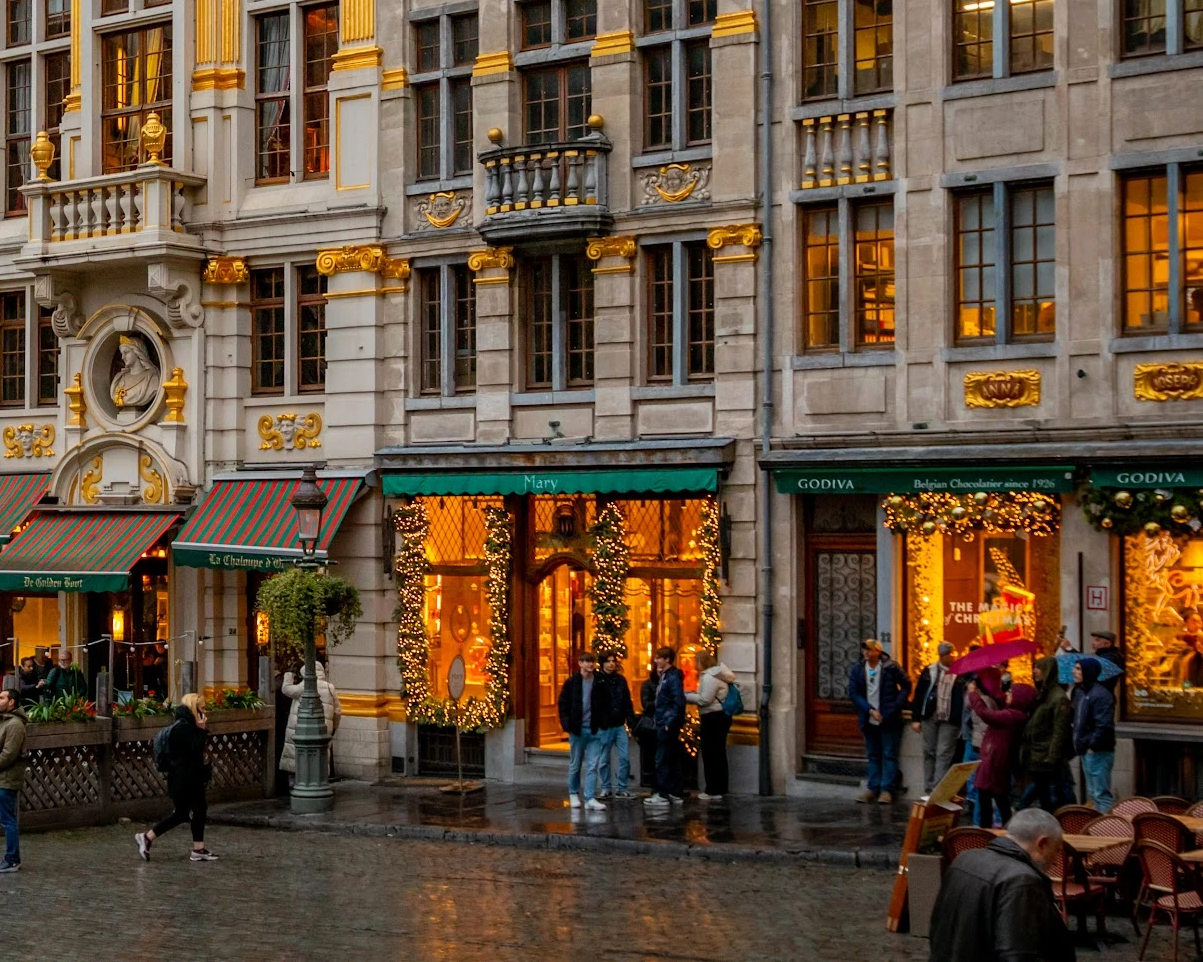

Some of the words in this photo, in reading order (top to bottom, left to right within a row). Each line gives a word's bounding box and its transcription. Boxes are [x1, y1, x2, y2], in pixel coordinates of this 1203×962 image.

[981, 382, 1021, 398] ANNA
[523, 474, 558, 493] Mary
[798, 478, 855, 489] GODIVA
[914, 479, 947, 491] Belgian
[949, 478, 1001, 489] Chocolatier
[1004, 478, 1029, 488] since
[1031, 478, 1055, 488] 1926
[1117, 472, 1186, 484] GODIVA
[208, 553, 221, 565] La
[222, 554, 264, 568] Chaloupe
[23, 576, 34, 587] De
[949, 601, 973, 612] THE
[978, 601, 1023, 613] MAGIC
